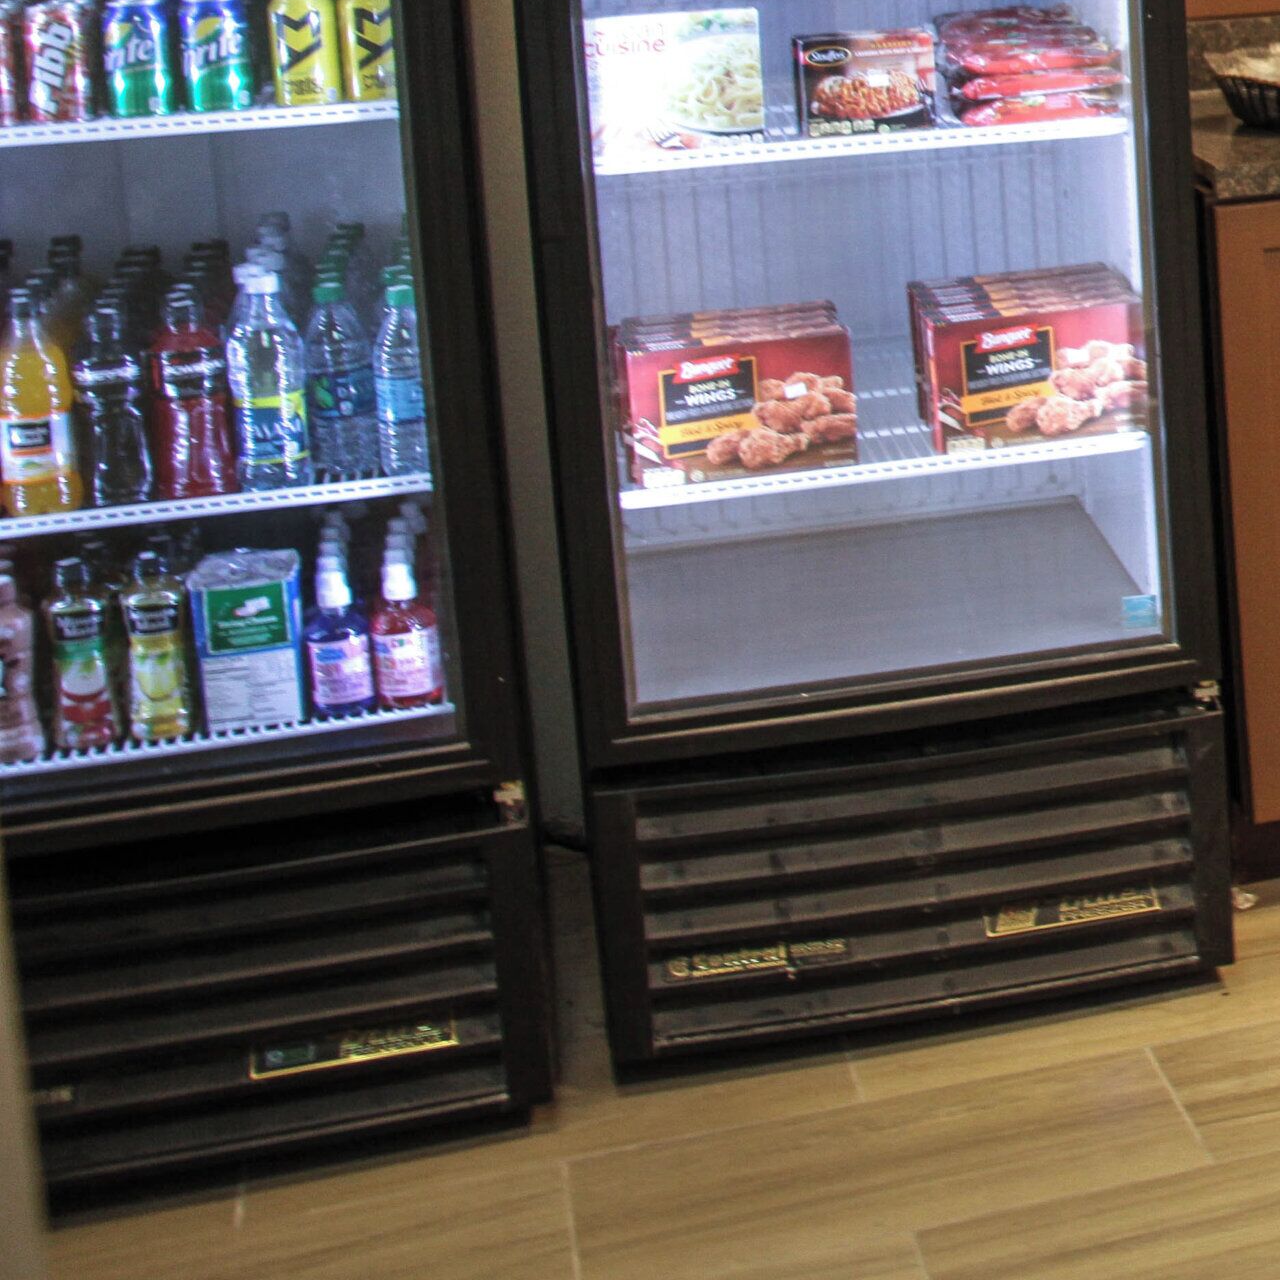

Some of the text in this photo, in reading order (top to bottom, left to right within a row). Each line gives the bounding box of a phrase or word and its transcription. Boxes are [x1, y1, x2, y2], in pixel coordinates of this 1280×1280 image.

[182, 31, 244, 78] prite
[984, 357, 1035, 376] WINGS
[684, 388, 737, 407] WINGS
